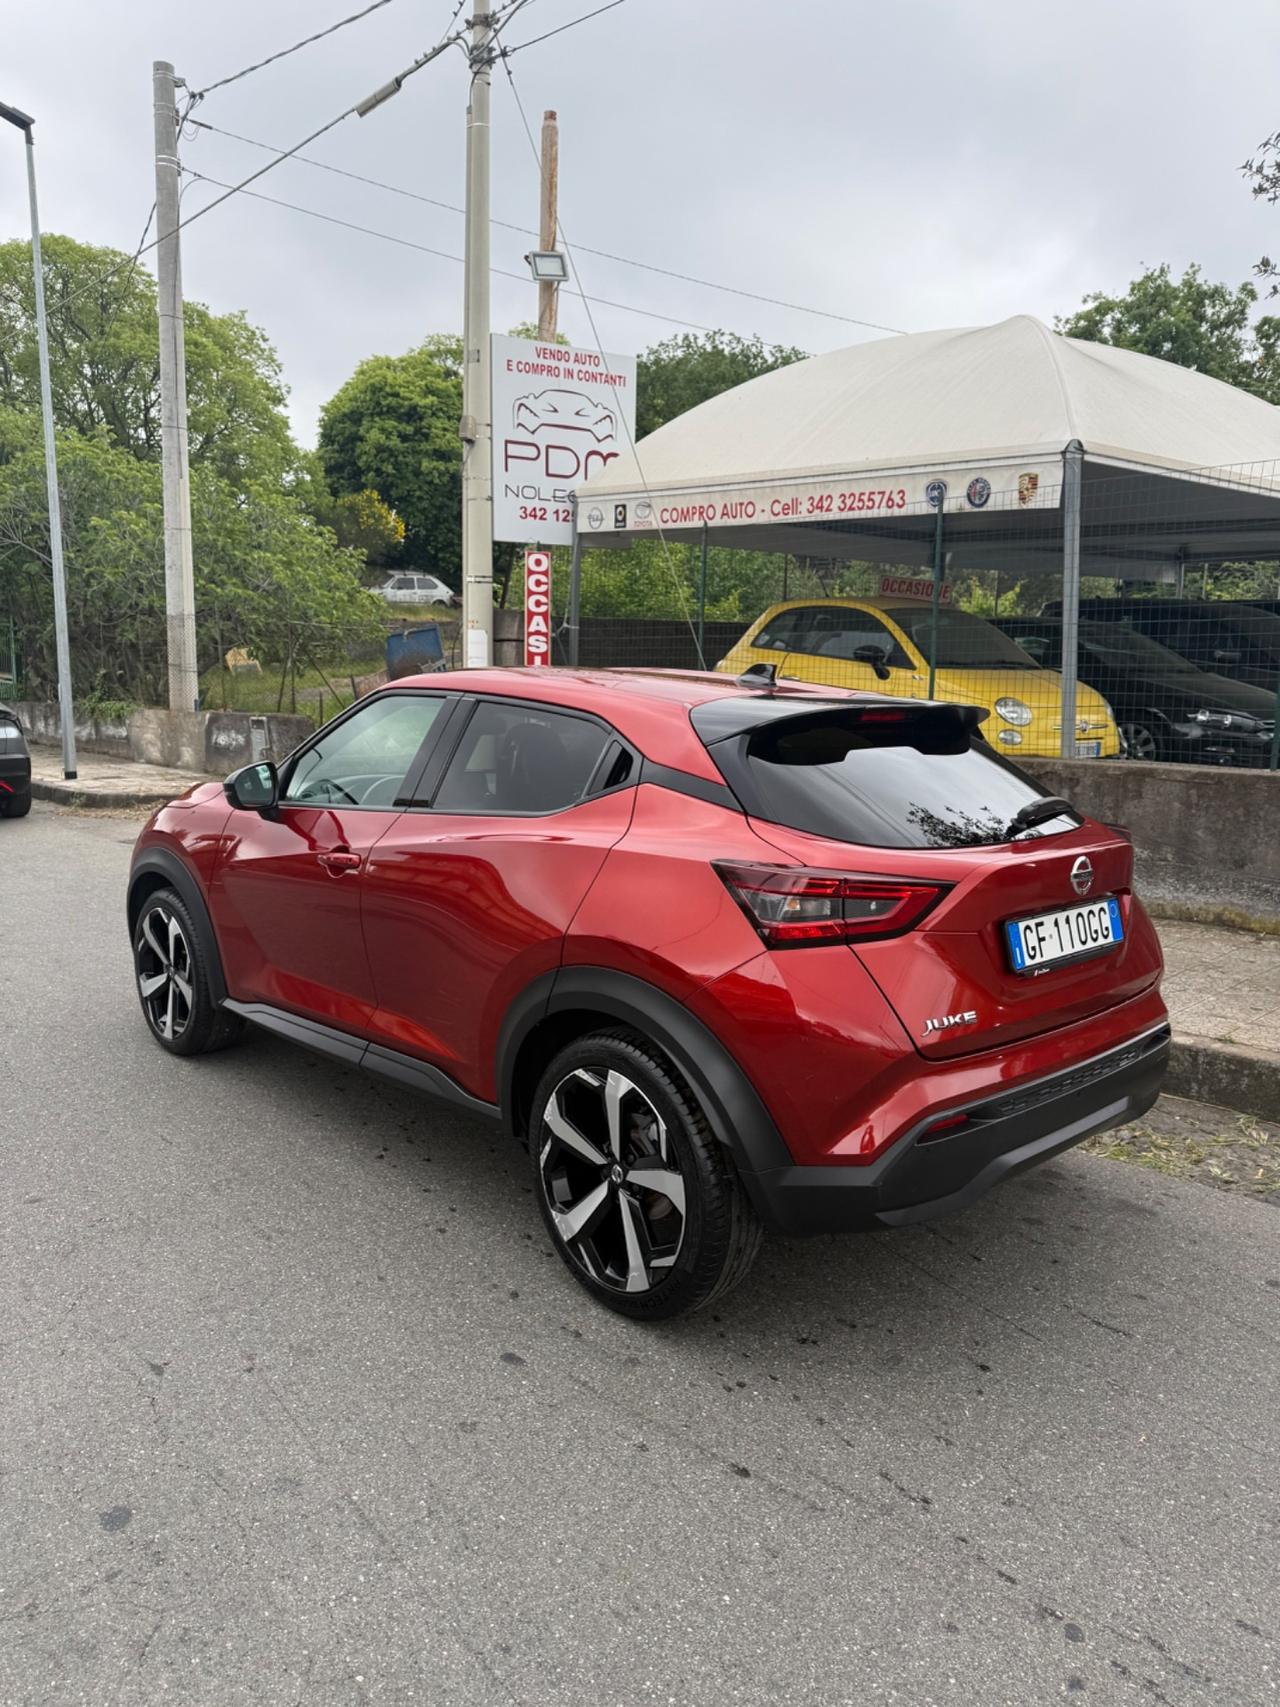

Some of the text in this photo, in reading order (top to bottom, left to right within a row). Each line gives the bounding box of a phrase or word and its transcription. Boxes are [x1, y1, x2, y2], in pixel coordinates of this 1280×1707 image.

[535, 346, 600, 368] VENDO AUTO
[506, 359, 626, 388] E COMPRO IN CONTANTI
[519, 506, 547, 521] 342
[660, 503, 716, 524] COMPRO
[720, 500, 755, 520] AUTO
[770, 498, 802, 517] Cell:
[806, 495, 833, 514] 342
[838, 489, 906, 512] 3255763
[921, 1010, 977, 1037] JUKE
